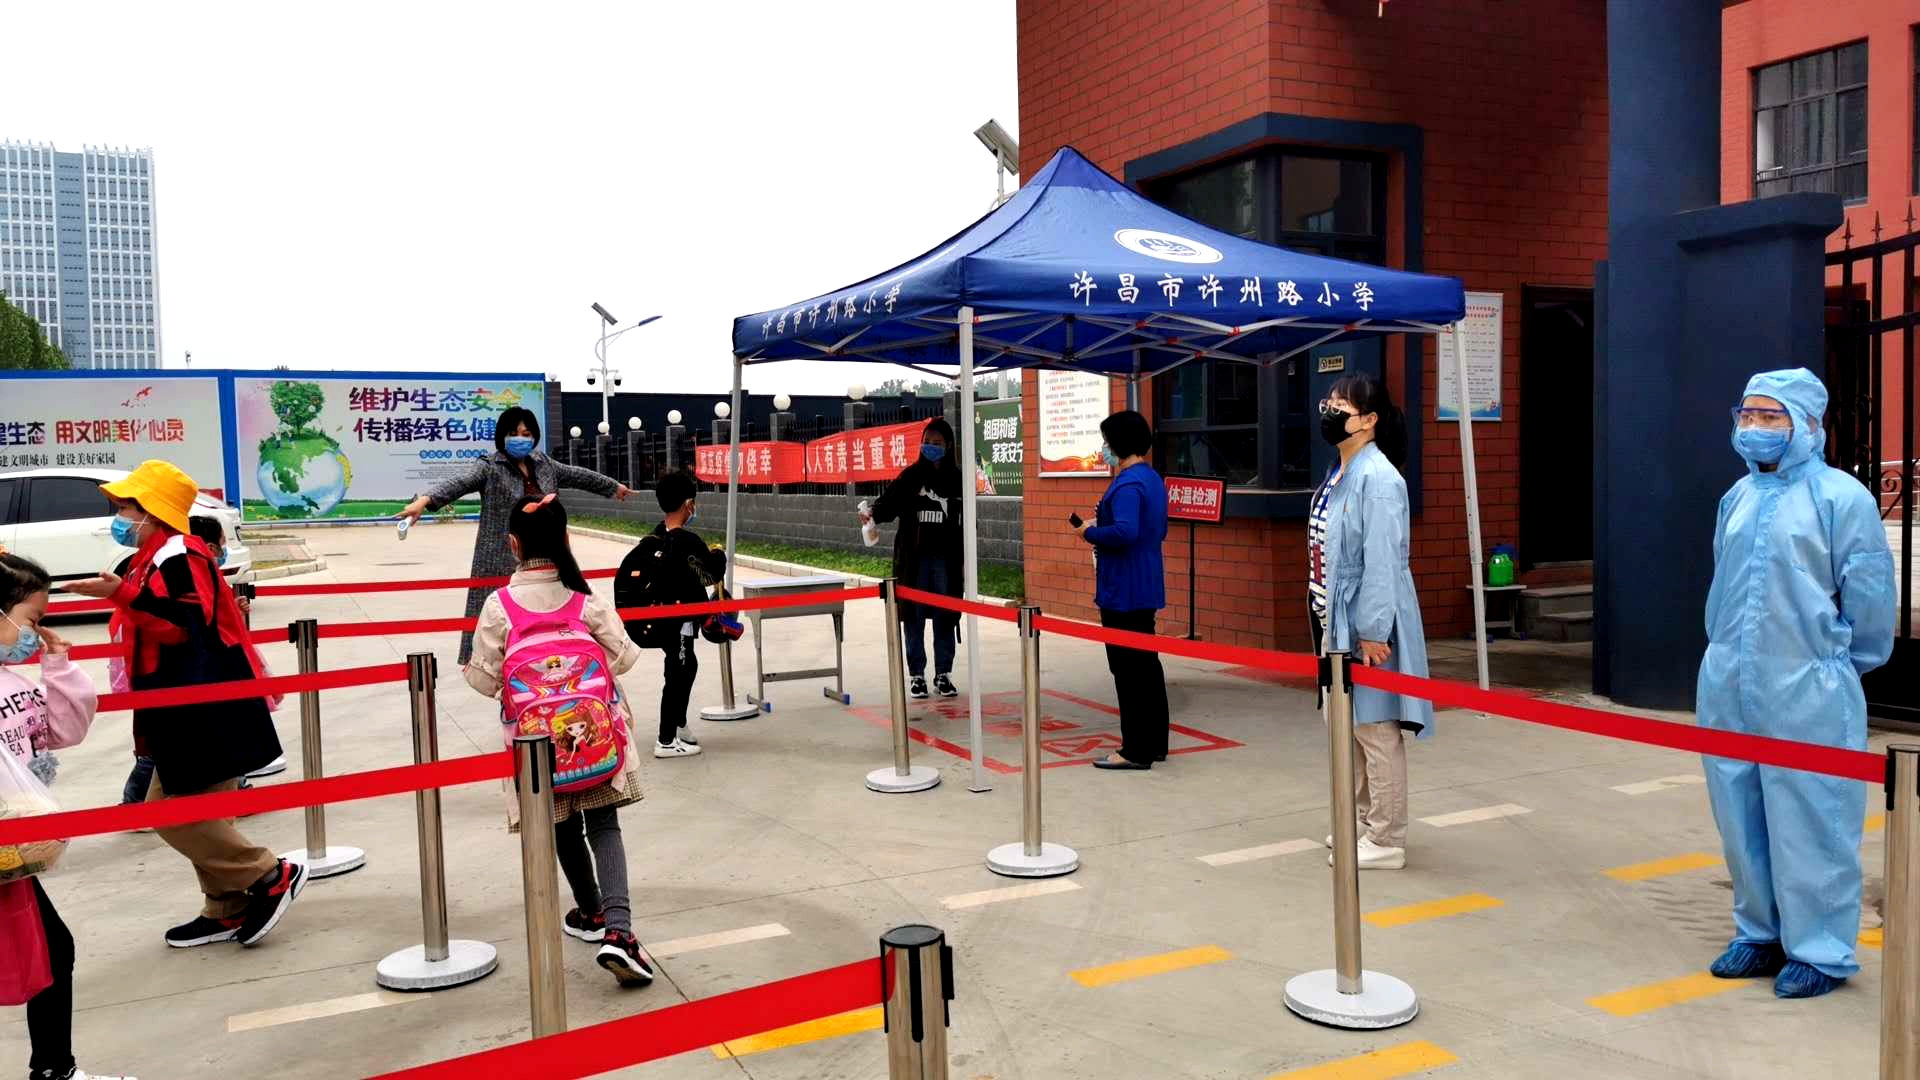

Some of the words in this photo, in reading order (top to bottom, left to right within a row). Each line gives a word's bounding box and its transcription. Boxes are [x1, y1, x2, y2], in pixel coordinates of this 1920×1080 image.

[1069, 270, 1375, 311] 许昌市许州路小学
[762, 282, 904, 341] 许昌市许州路小学
[349, 387, 522, 413] 维护生态安全
[55, 418, 185, 444] 用文明美化心灵
[983, 416, 1018, 441] 祖国和谐
[56, 452, 116, 466] 建设美好家园
[802, 433, 908, 474] 人人有责当重视
[1168, 484, 1217, 507] 体温检测
